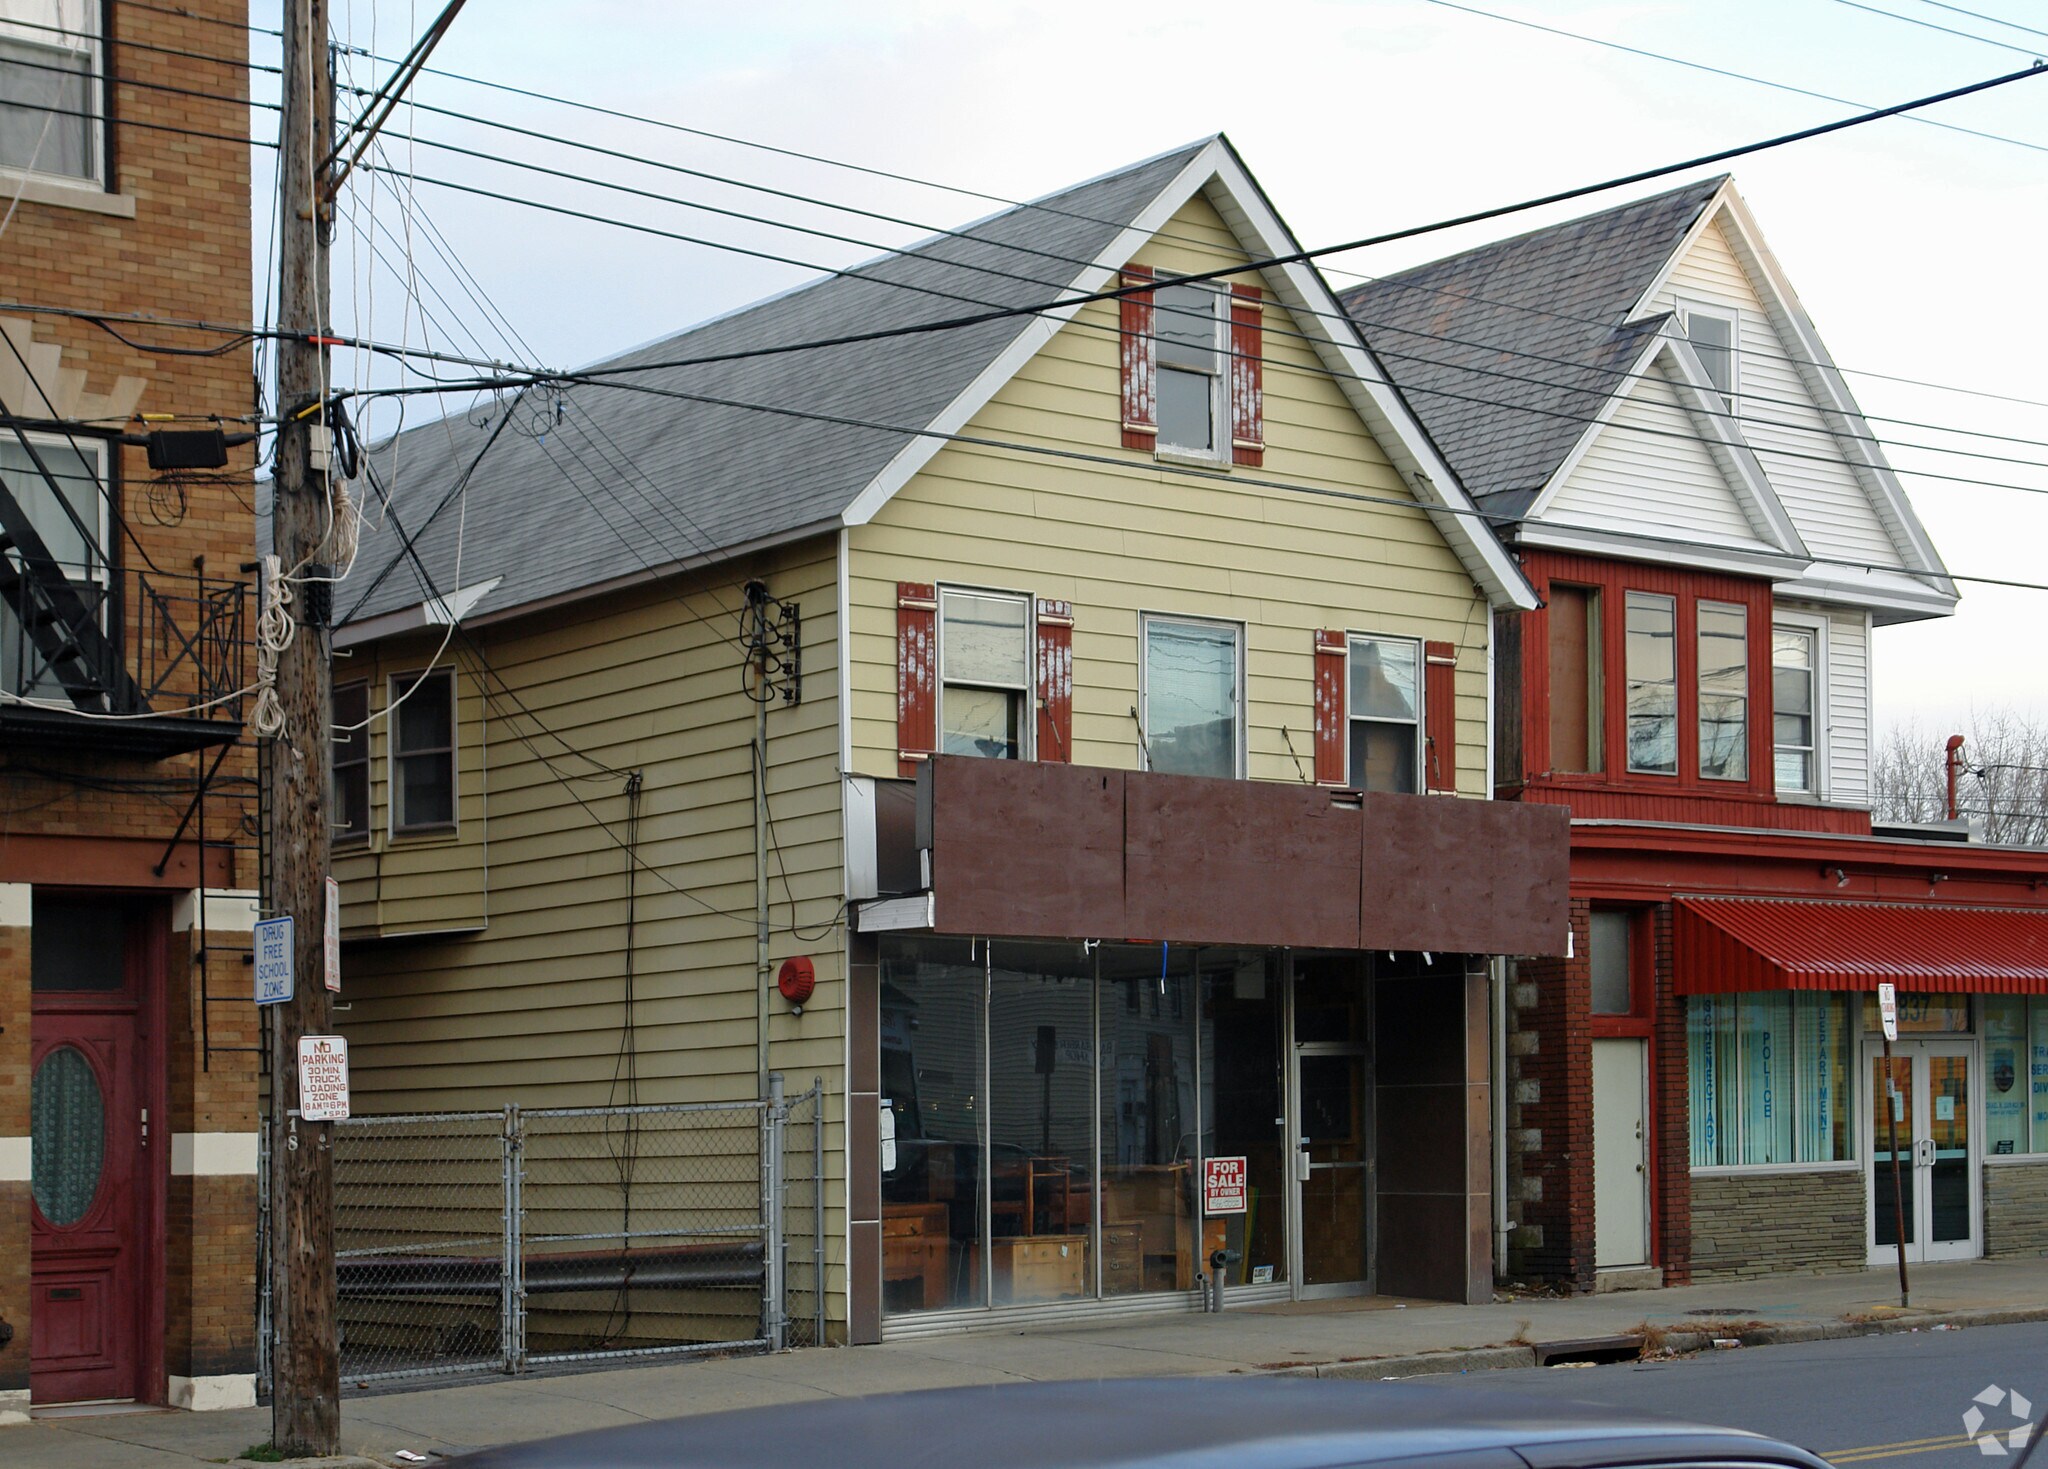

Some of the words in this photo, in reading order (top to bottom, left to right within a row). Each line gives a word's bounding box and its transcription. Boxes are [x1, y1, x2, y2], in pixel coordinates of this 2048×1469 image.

[263, 924, 284, 941] DRUG
[264, 943, 283, 960] FREE
[259, 961, 289, 979] SCHOOL
[264, 980, 284, 997] ZONE
[1898, 994, 1930, 1022] 837
[314, 1043, 331, 1053] NO
[302, 1054, 345, 1065] PARKING
[308, 1067, 321, 1075] 30
[1703, 999, 1715, 1152] SCHENECTADY
[1763, 1031, 1772, 1118] POLICE
[1818, 1007, 1828, 1140] DEPARTMENT
[308, 1075, 341, 1084] TRUCK
[304, 1084, 346, 1093] LOADING
[312, 1092, 339, 1102] ZONE
[1213, 1162, 1239, 1174] FOR
[1208, 1174, 1244, 1188] SALE
[1211, 1188, 1219, 1197] BY
[1220, 1187, 1240, 1196] OWNER
